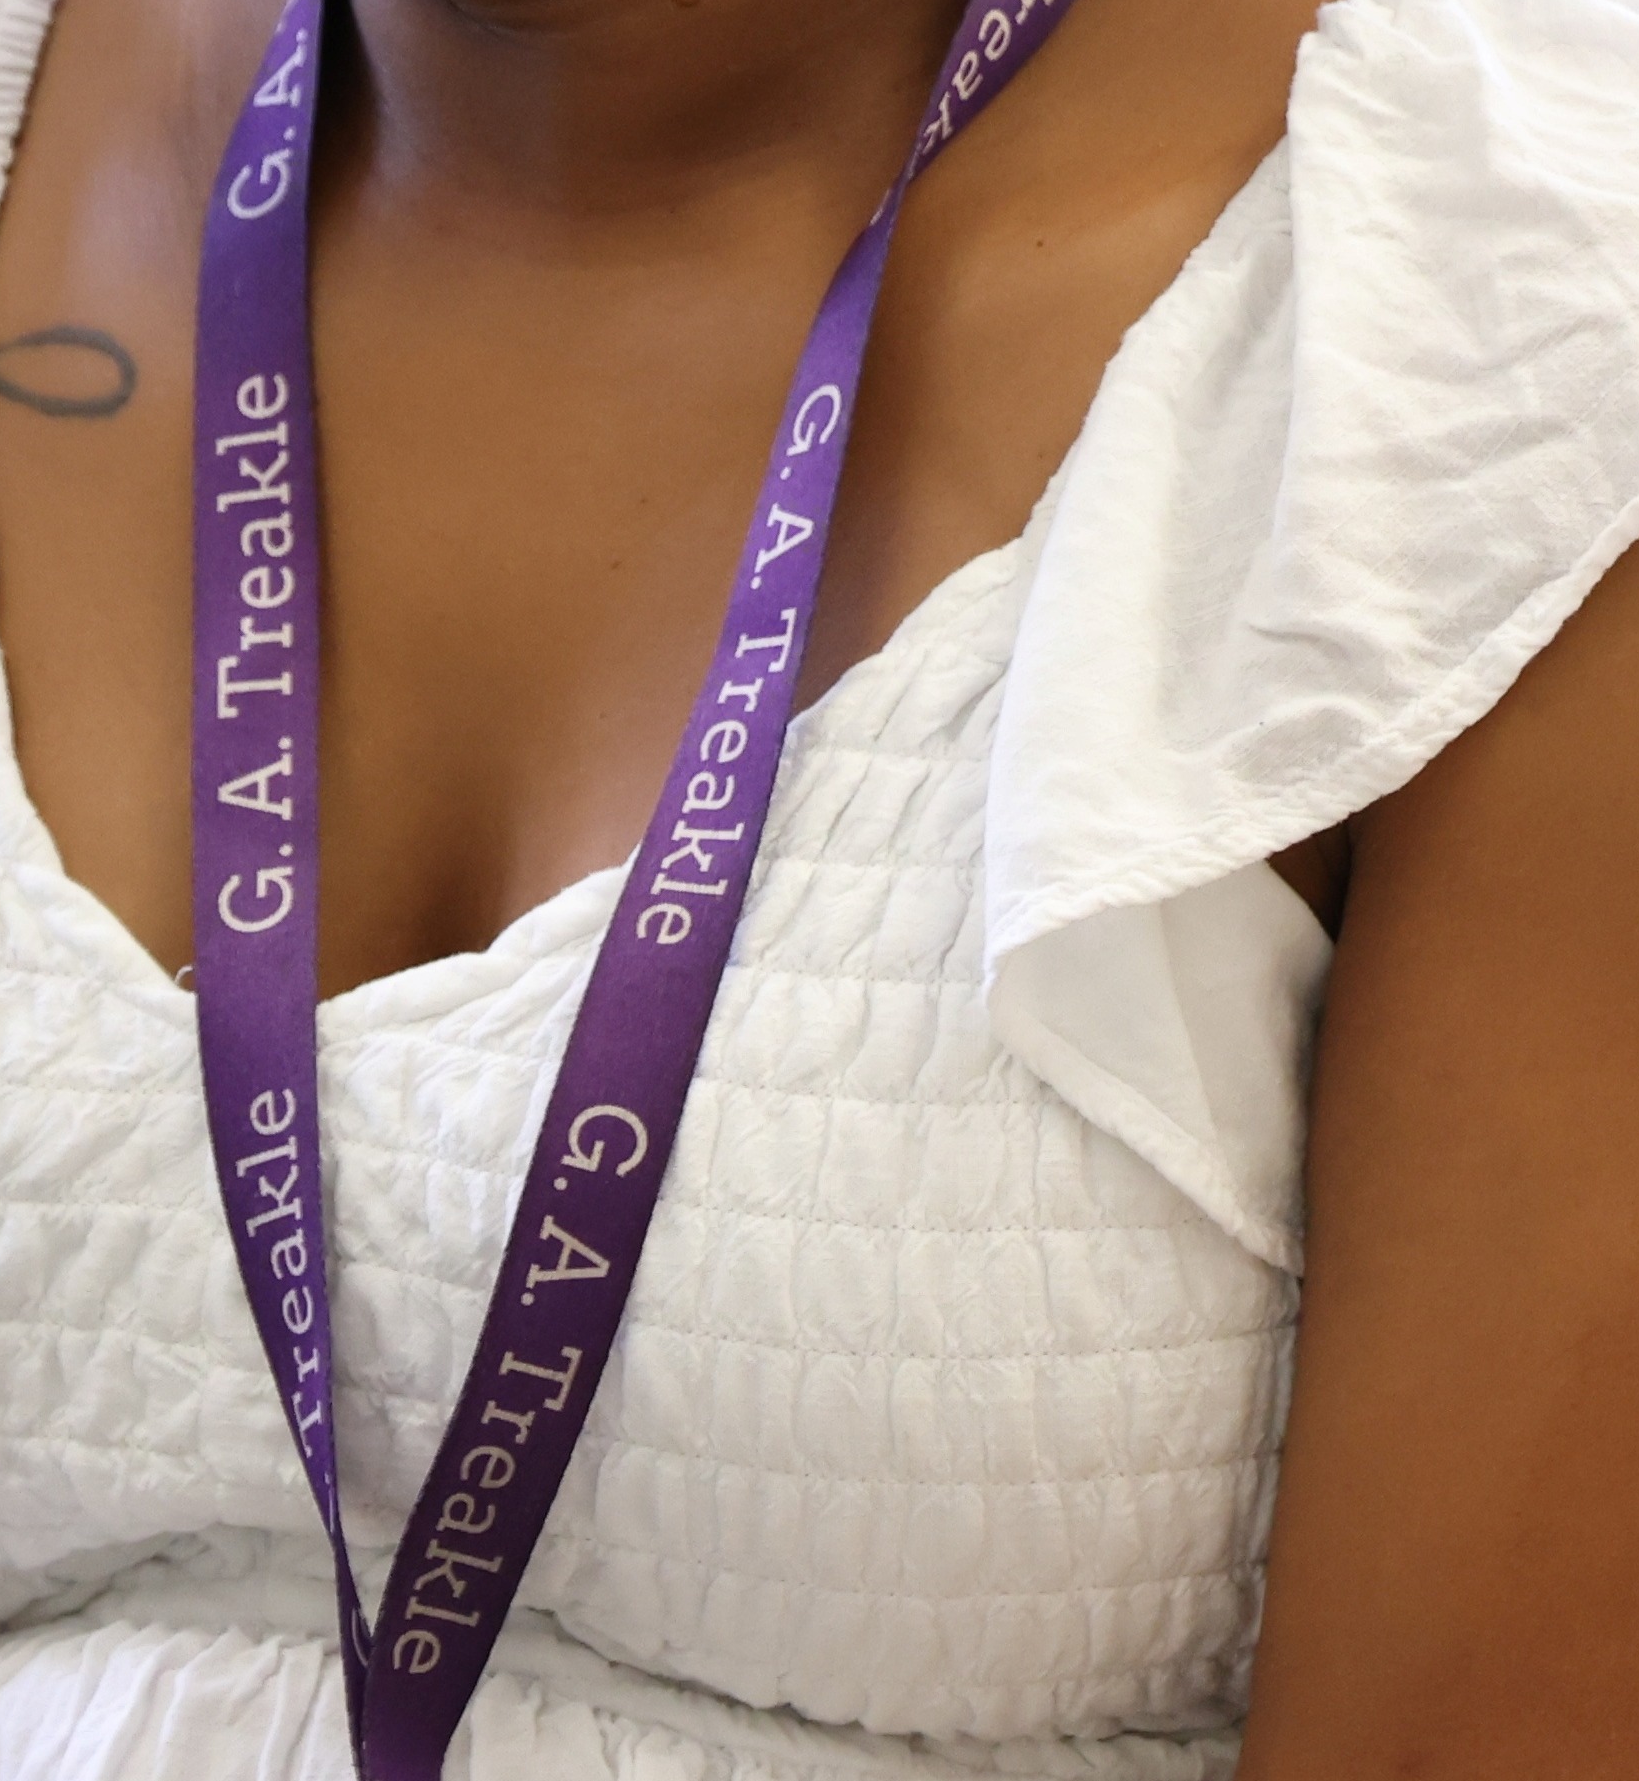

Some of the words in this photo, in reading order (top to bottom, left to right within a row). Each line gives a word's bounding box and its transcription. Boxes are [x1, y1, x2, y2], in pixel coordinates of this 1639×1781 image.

[253, 27, 309, 108] A.
[227, 125, 297, 220] G.
[779, 383, 842, 481] G.
[215, 371, 296, 720] Treakle
[749, 501, 815, 591] A.
[216, 736, 294, 822] A.
[635, 607, 798, 947] Treakle
[217, 842, 295, 934] G.
[553, 1104, 648, 1192] G.
[236, 1086, 325, 1458] Treakle
[520, 1215, 611, 1307] A.
[391, 1344, 584, 1675] Treakle
